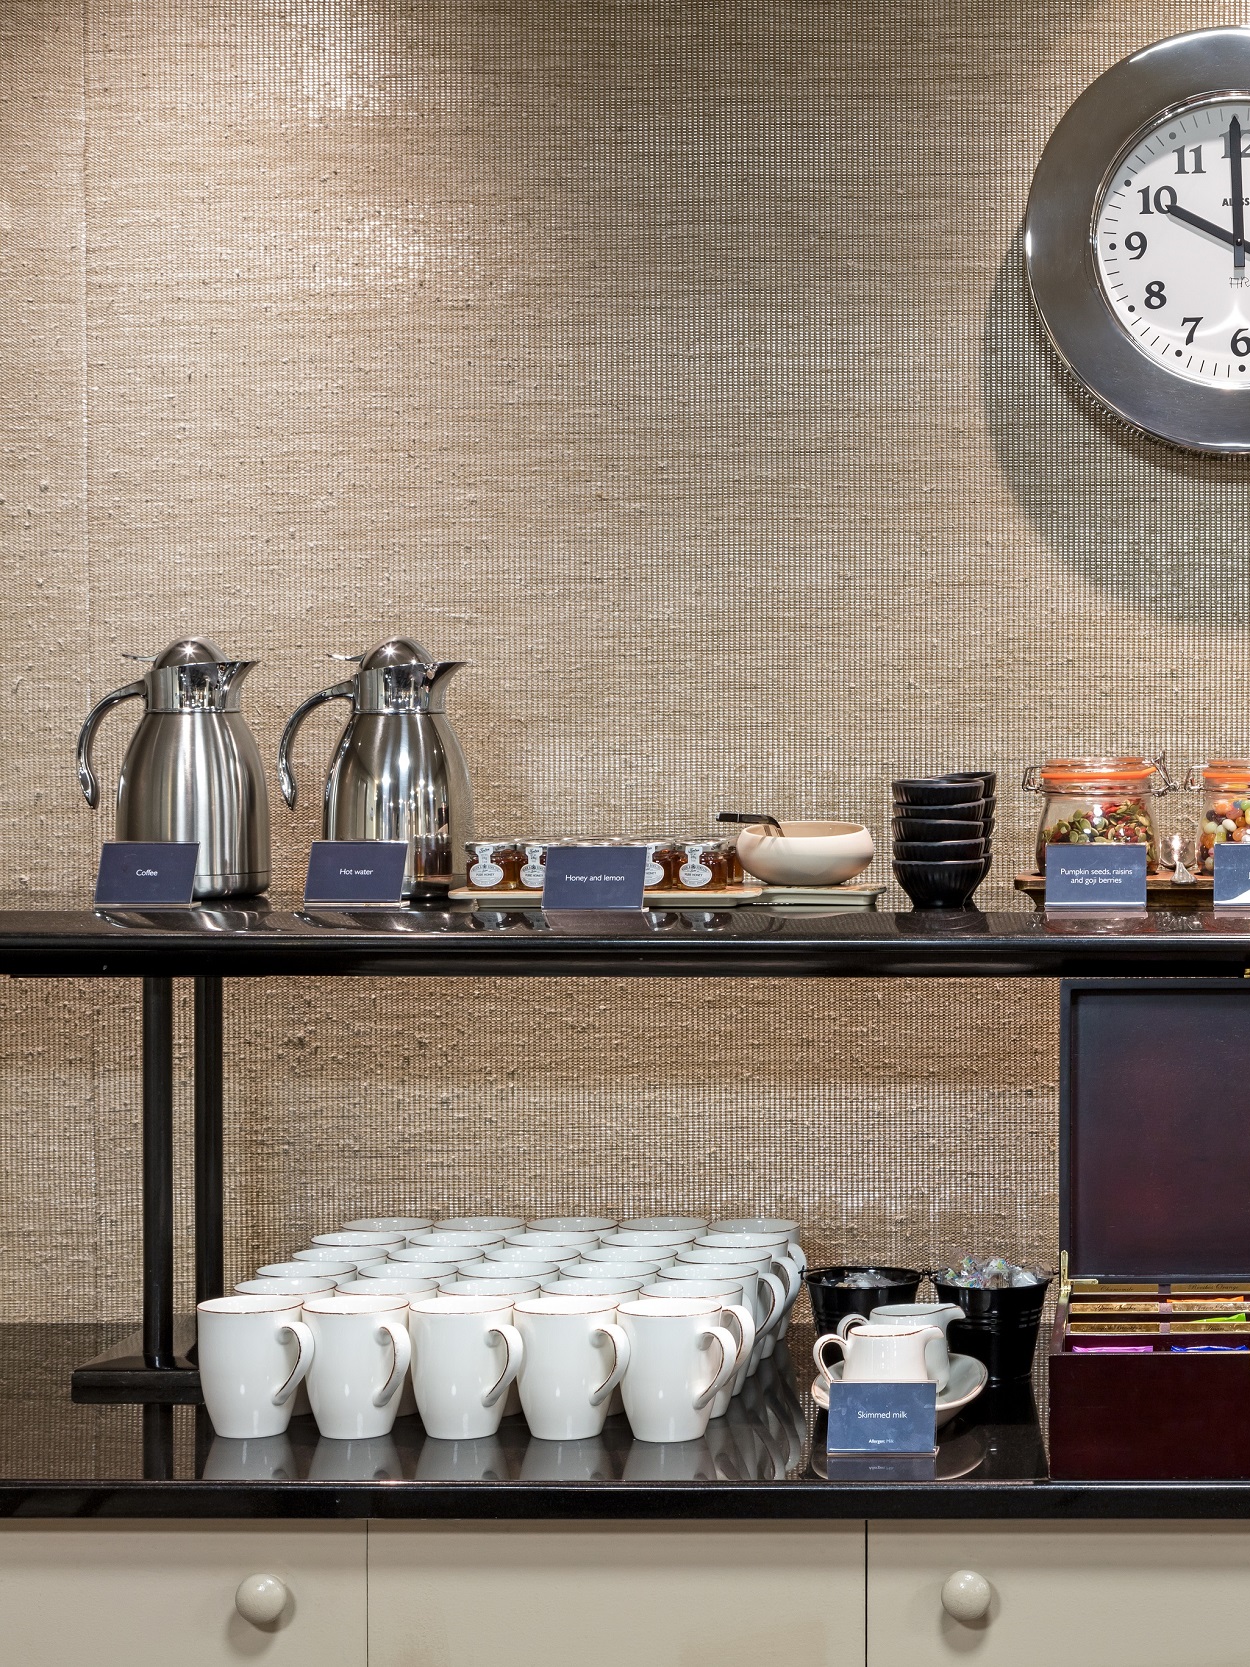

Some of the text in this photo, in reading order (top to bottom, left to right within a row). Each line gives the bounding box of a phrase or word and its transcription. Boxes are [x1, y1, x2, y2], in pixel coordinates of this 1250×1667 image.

[1172, 145, 1207, 174] 11
[1137, 186, 1178, 214] 10
[1124, 231, 1148, 260] 9
[1144, 281, 1167, 310] 8
[1181, 316, 1204, 346] 7
[1060, 868, 1090, 876] Pumpkin
[1084, 877, 1097, 885] goji
